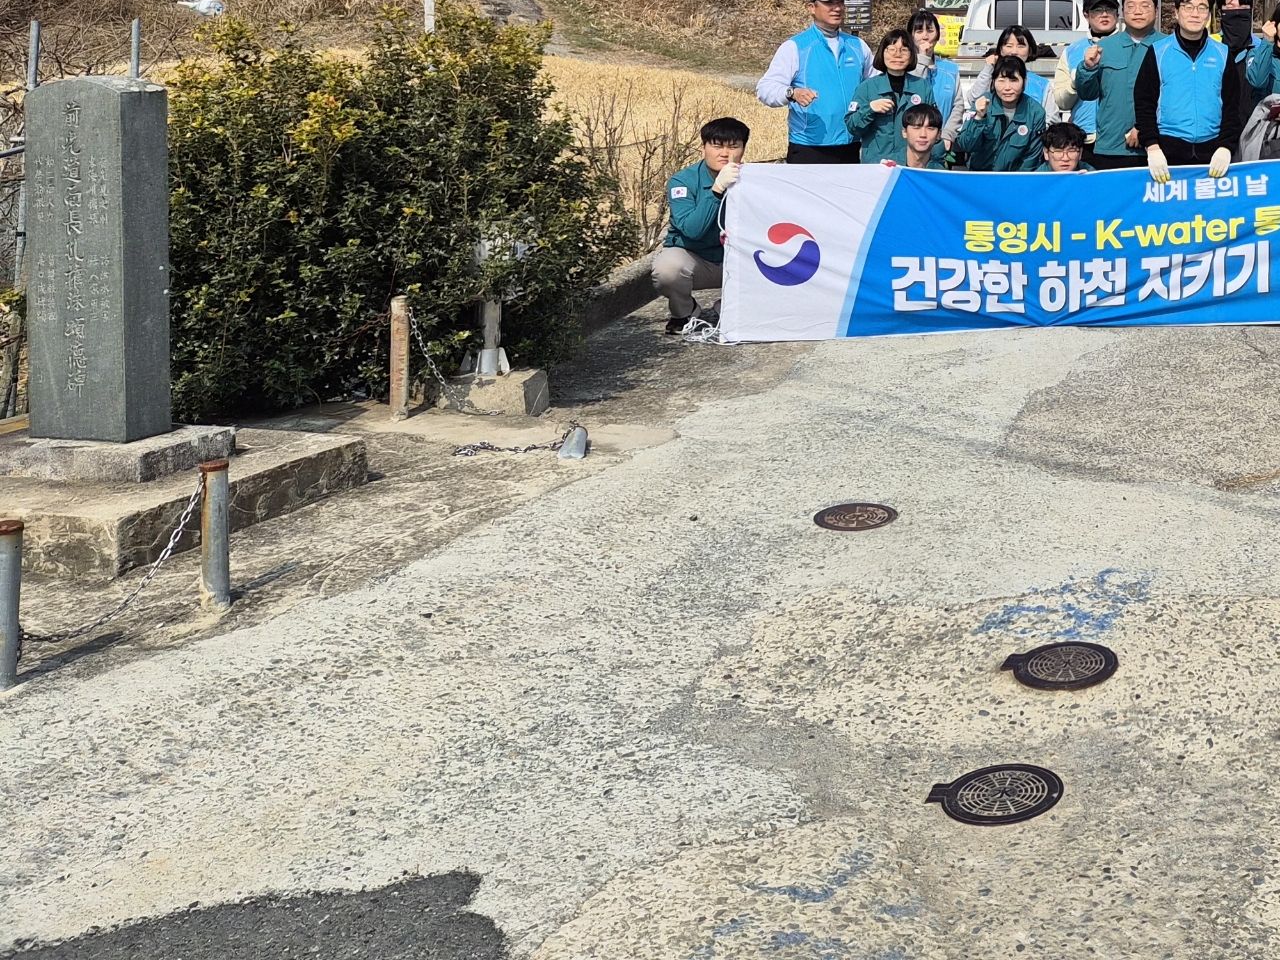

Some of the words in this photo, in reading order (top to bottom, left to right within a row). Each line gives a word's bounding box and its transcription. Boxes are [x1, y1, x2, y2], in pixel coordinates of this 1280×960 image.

[1143, 179, 1188, 203] 세계
[1195, 176, 1239, 200] 물의
[1246, 174, 1269, 196] 날
[963, 220, 1061, 254] 통영시
[1096, 214, 1245, 250] K-water
[891, 256, 1028, 314] 건강한
[1038, 257, 1127, 313] 하천
[1138, 240, 1270, 302] 지키기
